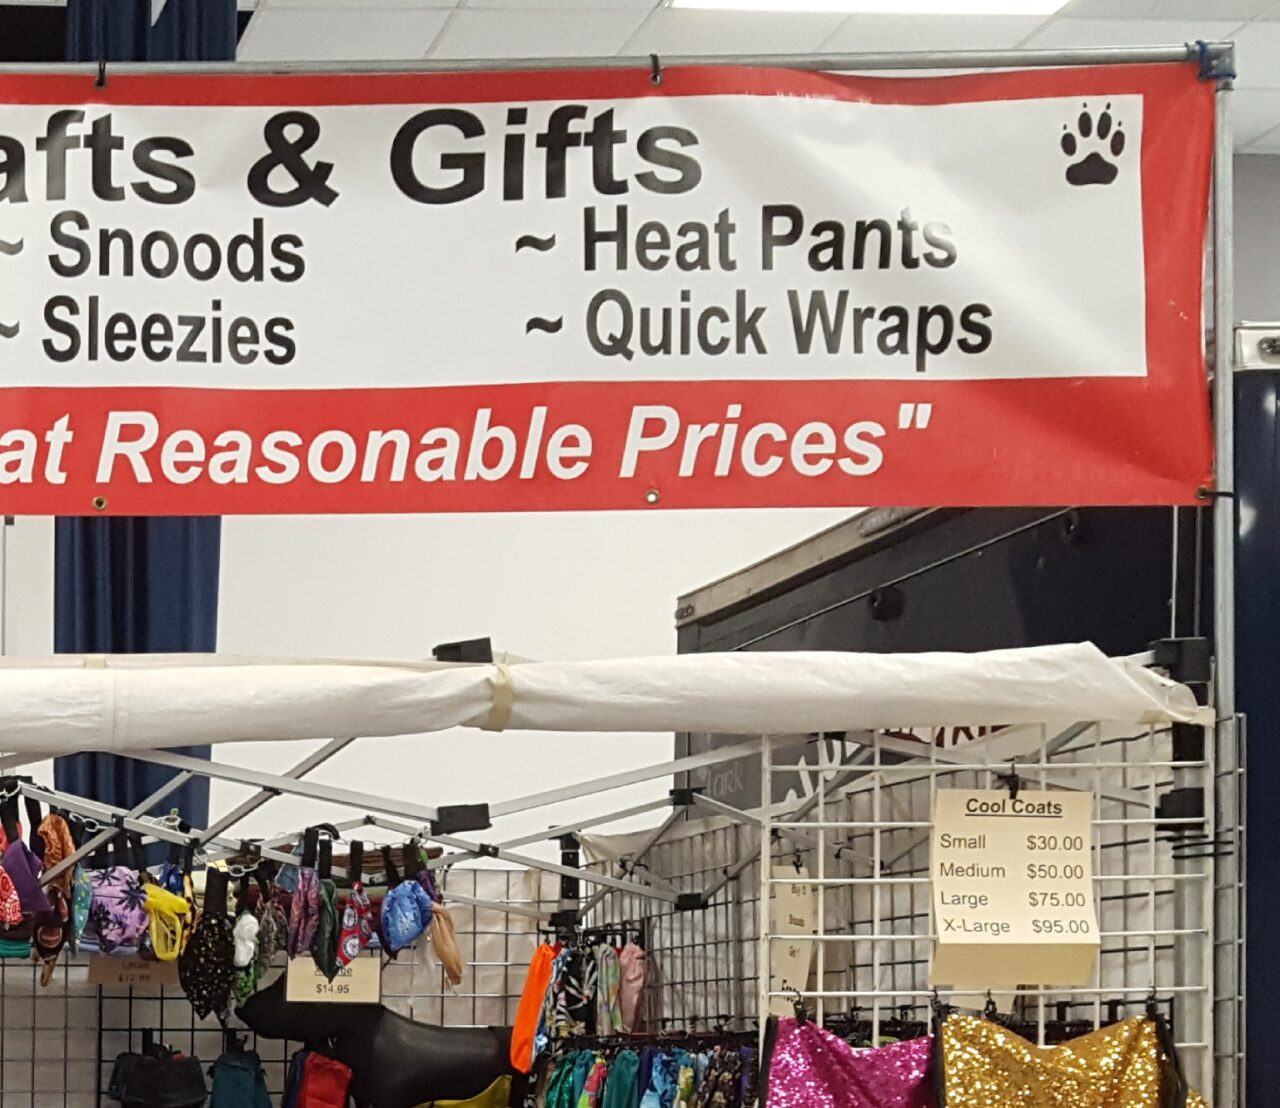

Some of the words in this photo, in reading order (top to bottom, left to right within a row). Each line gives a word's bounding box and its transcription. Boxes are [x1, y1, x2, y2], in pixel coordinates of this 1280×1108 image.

[246, 110, 341, 208] &
[389, 104, 703, 205] Gifts
[48, 210, 306, 283] Snoods
[582, 204, 737, 272] Heat
[762, 203, 958, 272] Pants
[41, 295, 297, 365] Sleezies
[585, 288, 768, 361] Quick
[787, 288, 993, 372] Wraps
[95, 406, 593, 486] Reasonable
[619, 402, 932, 479] Prices"
[965, 798, 1006, 815] Cool
[1011, 799, 1063, 815] Coats
[939, 833, 987, 849] Small
[1026, 835, 1084, 851] $30.00
[939, 863, 1006, 879] Medium
[1026, 863, 1084, 880] $50.00
[940, 891, 989, 909] Large
[1028, 892, 1086, 909] $75.00
[943, 919, 1011, 935] X-Large
[1032, 919, 1090, 934] $95.00
[316, 984, 350, 994] $14.95
